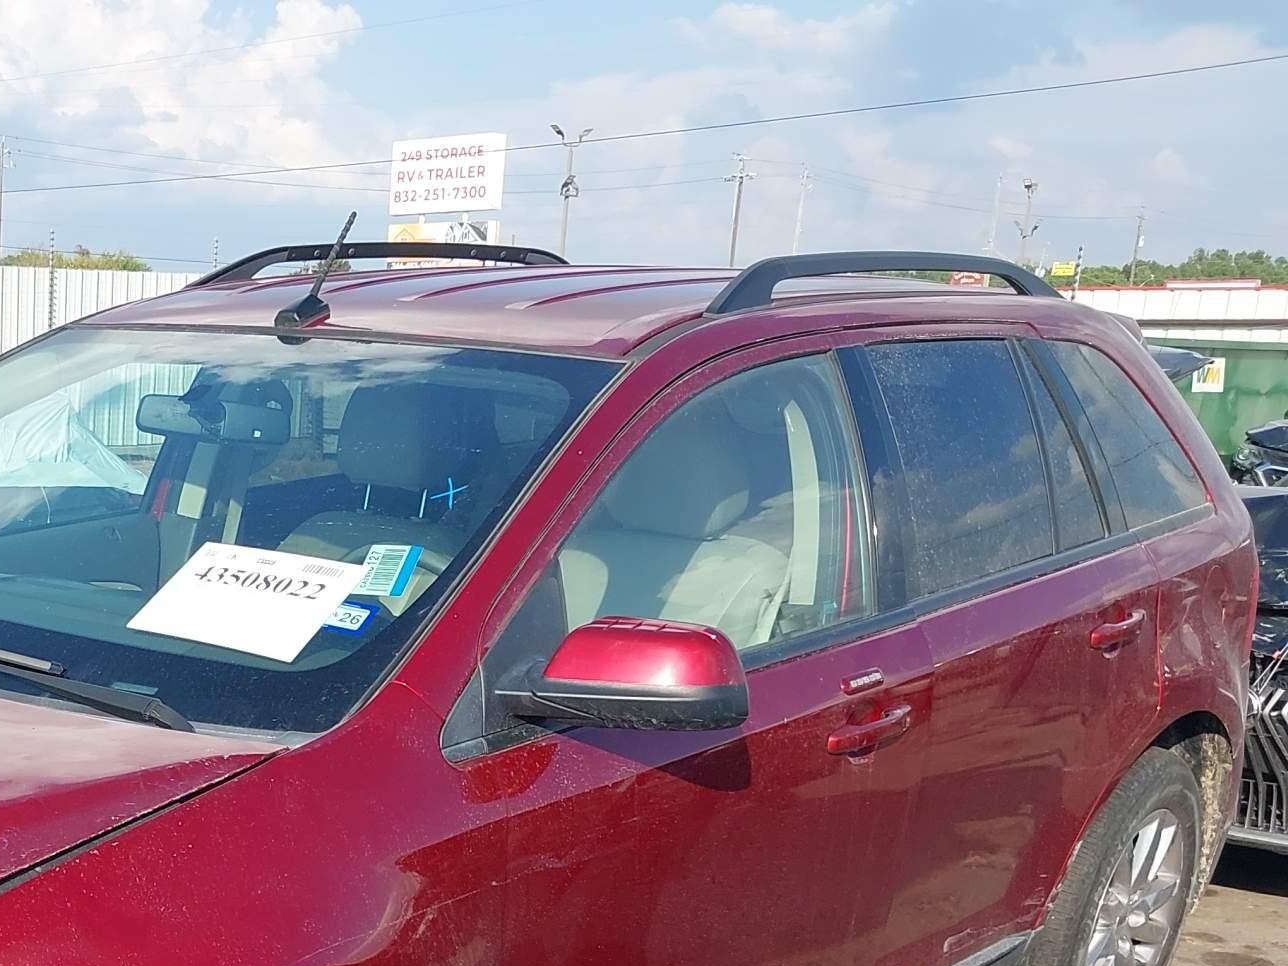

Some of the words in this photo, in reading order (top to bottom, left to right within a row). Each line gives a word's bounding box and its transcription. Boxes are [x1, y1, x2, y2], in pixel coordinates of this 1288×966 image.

[400, 150, 422, 162] 249
[425, 145, 485, 160] STORAGE
[396, 170, 416, 183] RV
[427, 165, 486, 181] TRAILER
[194, 566, 327, 600] 43508022
[338, 612, 363, 625] 26
